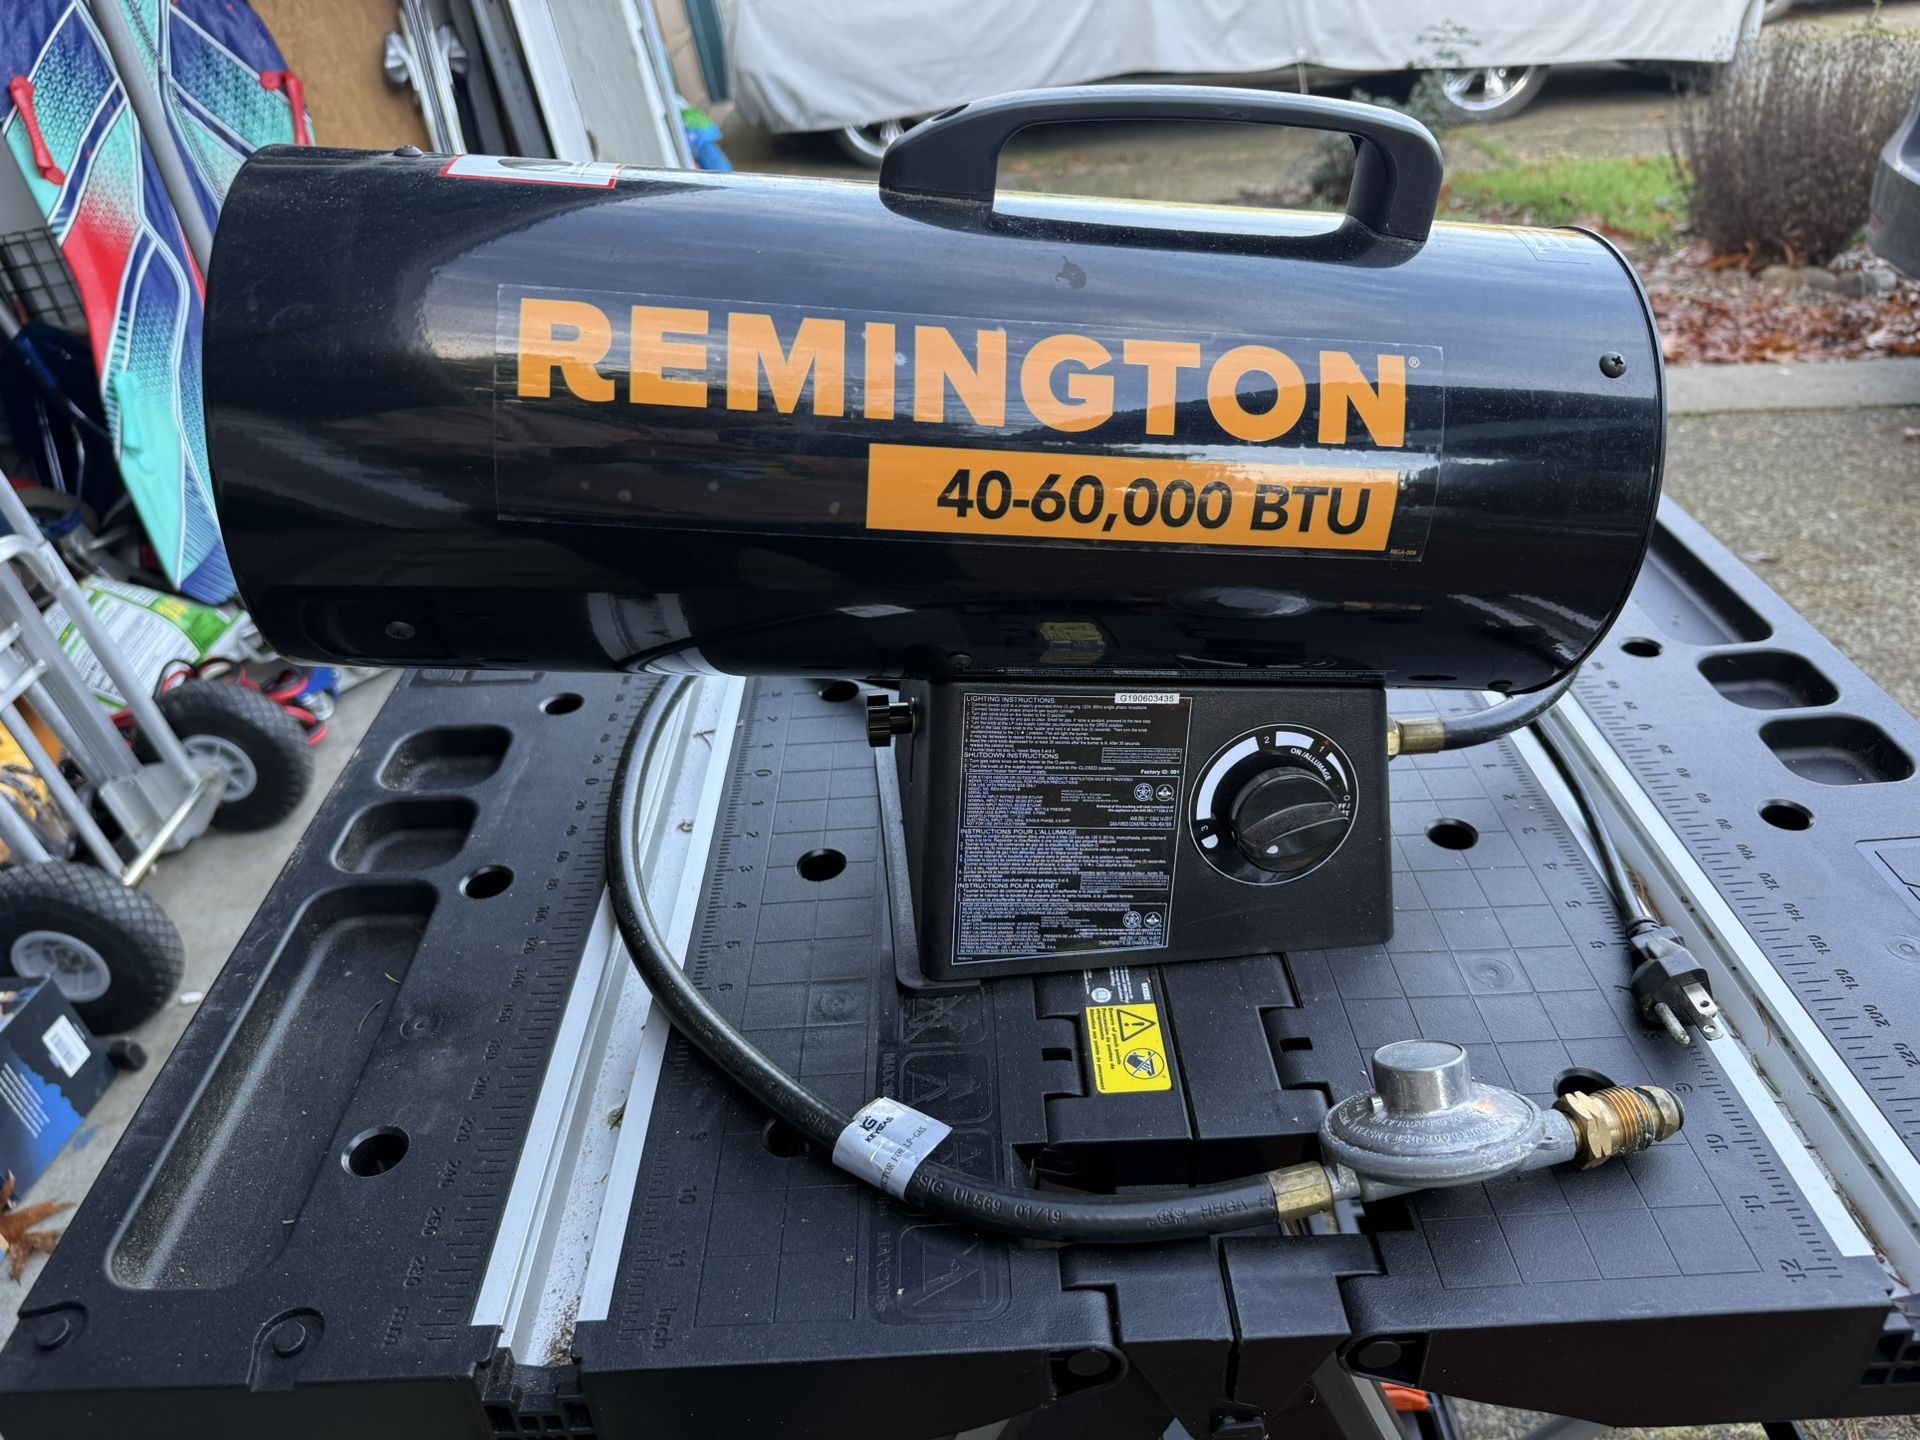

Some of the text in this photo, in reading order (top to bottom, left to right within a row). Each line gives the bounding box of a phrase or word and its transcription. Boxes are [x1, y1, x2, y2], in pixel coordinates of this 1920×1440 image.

[518, 298, 1406, 447] REMINGTON
[937, 468, 1371, 535] 40-60,000 BTU
[1120, 694, 1174, 702] G190603435
[592, 754, 603, 765] 20
[753, 770, 772, 778] 0
[586, 778, 600, 786] 0
[575, 800, 588, 812] 20
[566, 824, 578, 837] 40
[746, 831, 759, 839] 2
[557, 851, 570, 863] 60
[739, 865, 753, 873] 3
[546, 878, 560, 891] 80
[1657, 744, 1673, 755] 20
[1676, 767, 1690, 779] 40
[1696, 792, 1711, 804] 60
[1758, 873, 1780, 890] 120
[1782, 902, 1804, 921] 140
[1863, 1004, 1892, 1027] 200
[524, 936, 538, 954] 120
[724, 941, 741, 950] 5
[718, 983, 733, 992] 6
[1523, 826, 1537, 835] 3
[1542, 862, 1558, 870] 4
[1566, 900, 1582, 909] 5
[1675, 1083, 1693, 1093] 9
[1705, 1134, 1728, 1154] 10
[1740, 1195, 1766, 1213] 11
[1778, 1258, 1806, 1283] 12
[455, 1117, 476, 1143] 220
[865, 1116, 894, 1142] KEYGAS
[691, 1132, 707, 1142] 9
[891, 1147, 903, 1162] FOR
[903, 1126, 927, 1150] LP-GAS
[678, 1185, 698, 1205] 10
[953, 1184, 1002, 1213] UL569
[1015, 1203, 1062, 1224] 01/19
[665, 1249, 685, 1269] 11
[653, 1308, 678, 1348] Inch
